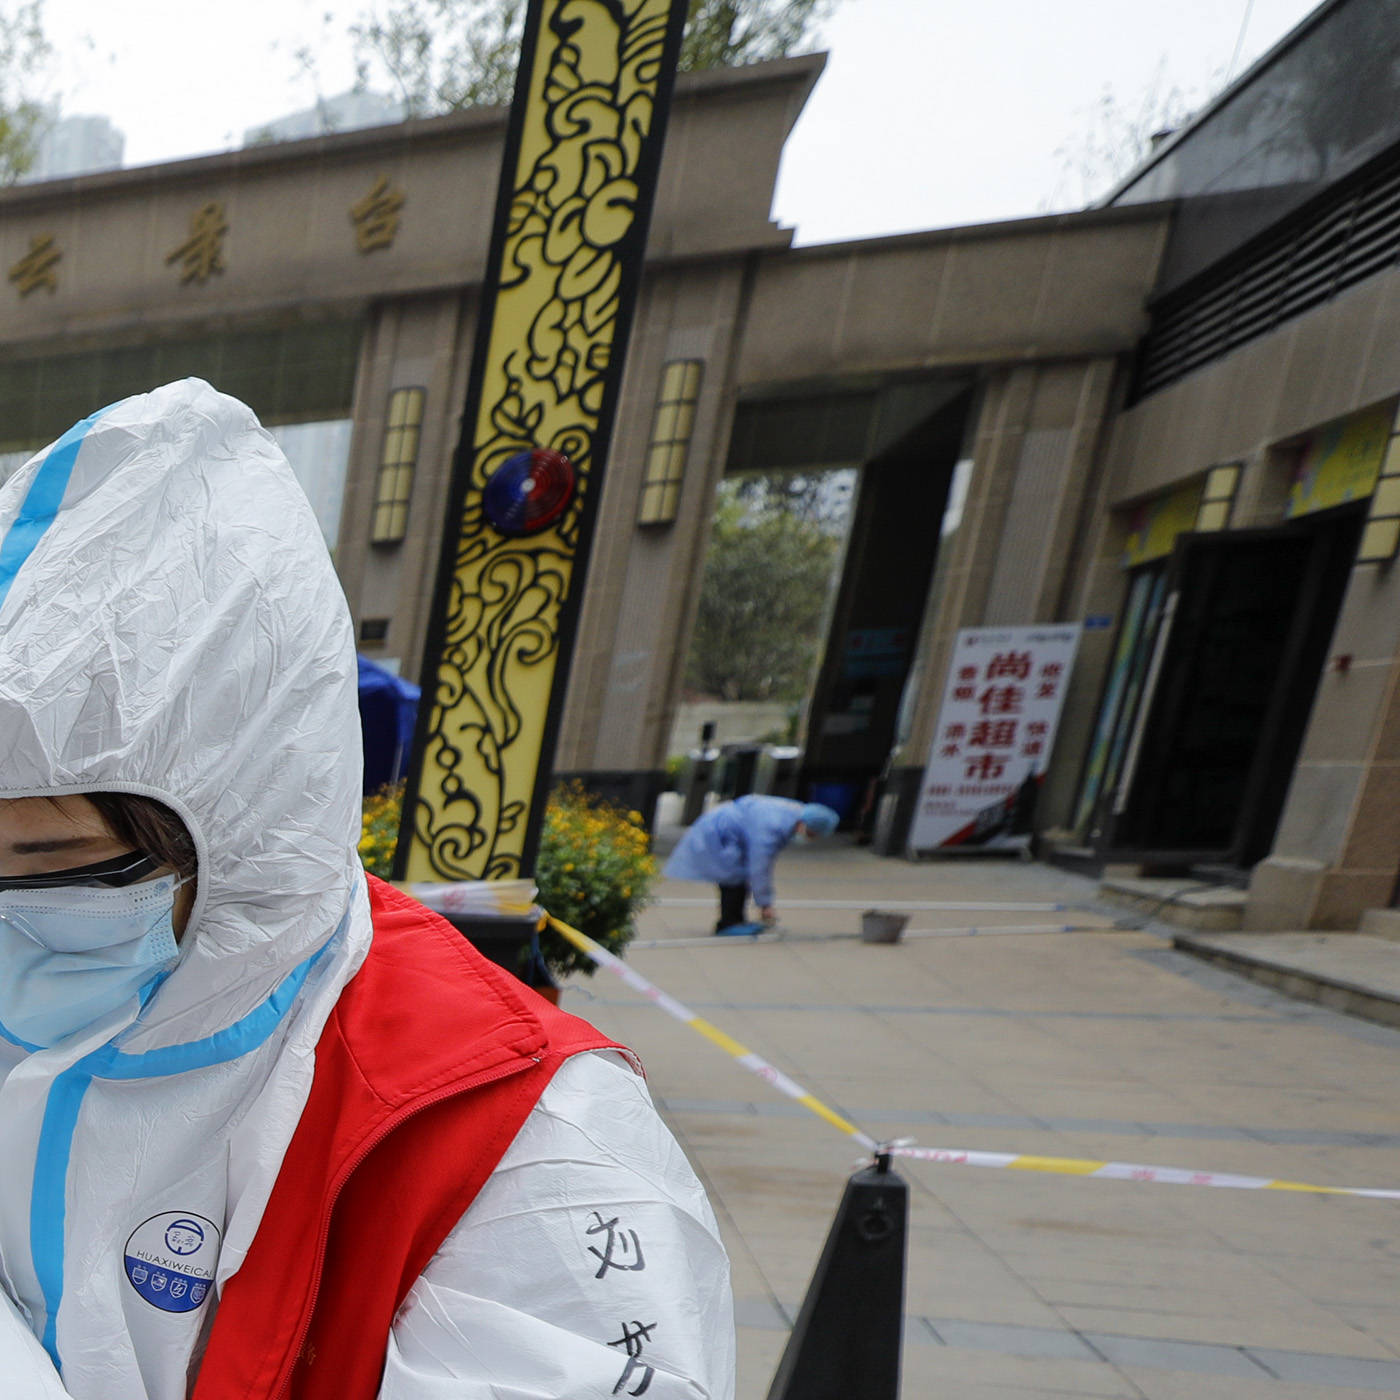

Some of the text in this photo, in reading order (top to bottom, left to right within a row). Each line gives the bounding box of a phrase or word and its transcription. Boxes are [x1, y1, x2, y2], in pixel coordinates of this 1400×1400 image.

[964, 651, 1033, 780] 尚佳超市
[136, 1249, 213, 1278] HUAXIWEICAI
[585, 1211, 658, 1397] 刘芳
